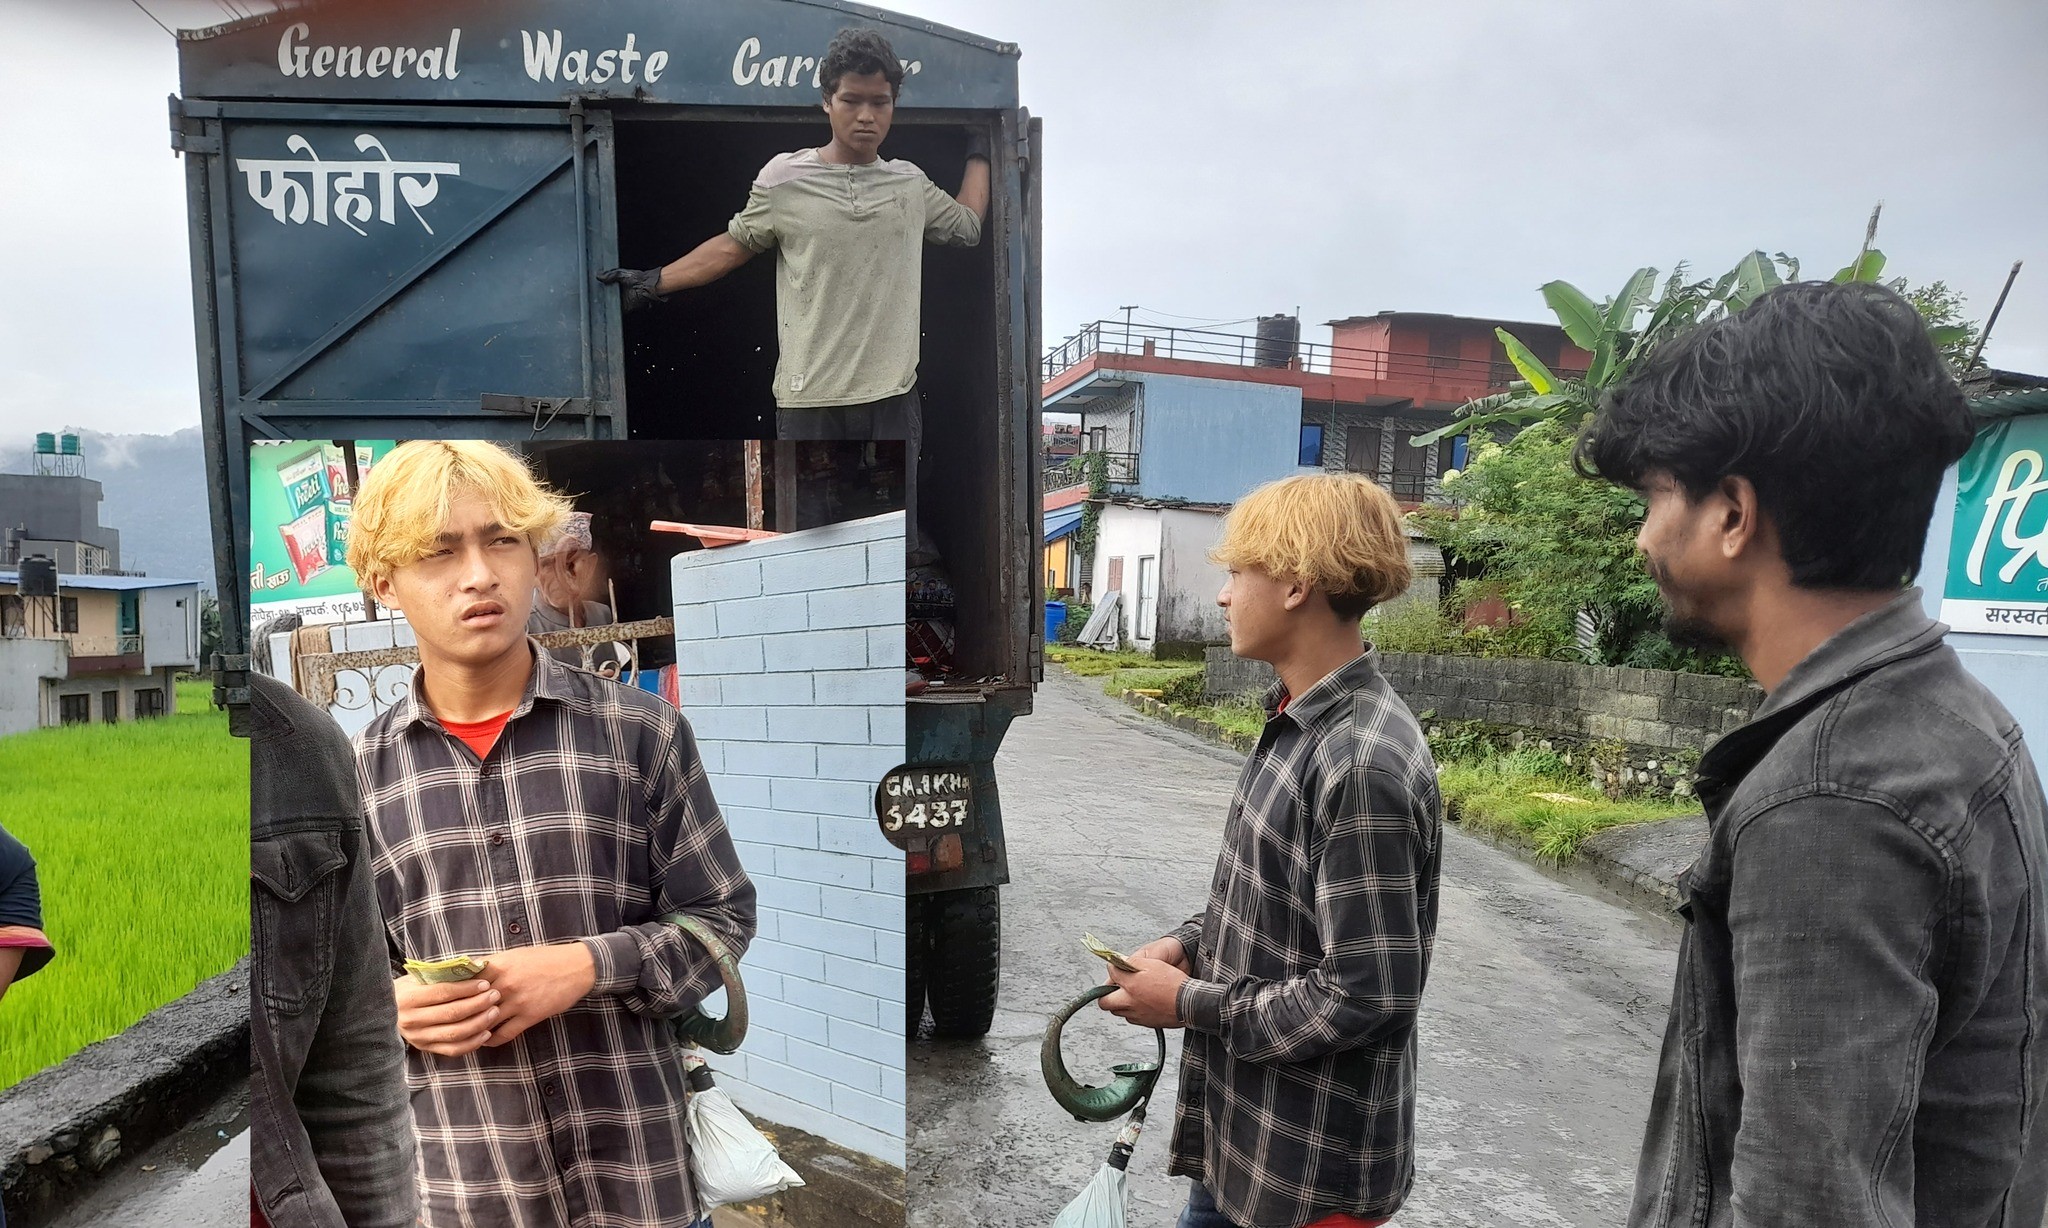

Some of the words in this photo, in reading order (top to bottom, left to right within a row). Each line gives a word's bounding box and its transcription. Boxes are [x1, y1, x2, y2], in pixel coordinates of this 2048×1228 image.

[278, 23, 461, 80] General
[521, 28, 669, 85] Waste
[732, 37, 922, 89] Carr
[236, 134, 460, 237] फोहोर
[1985, 606, 2048, 625] सरस्वत
[885, 799, 968, 831] 5437
